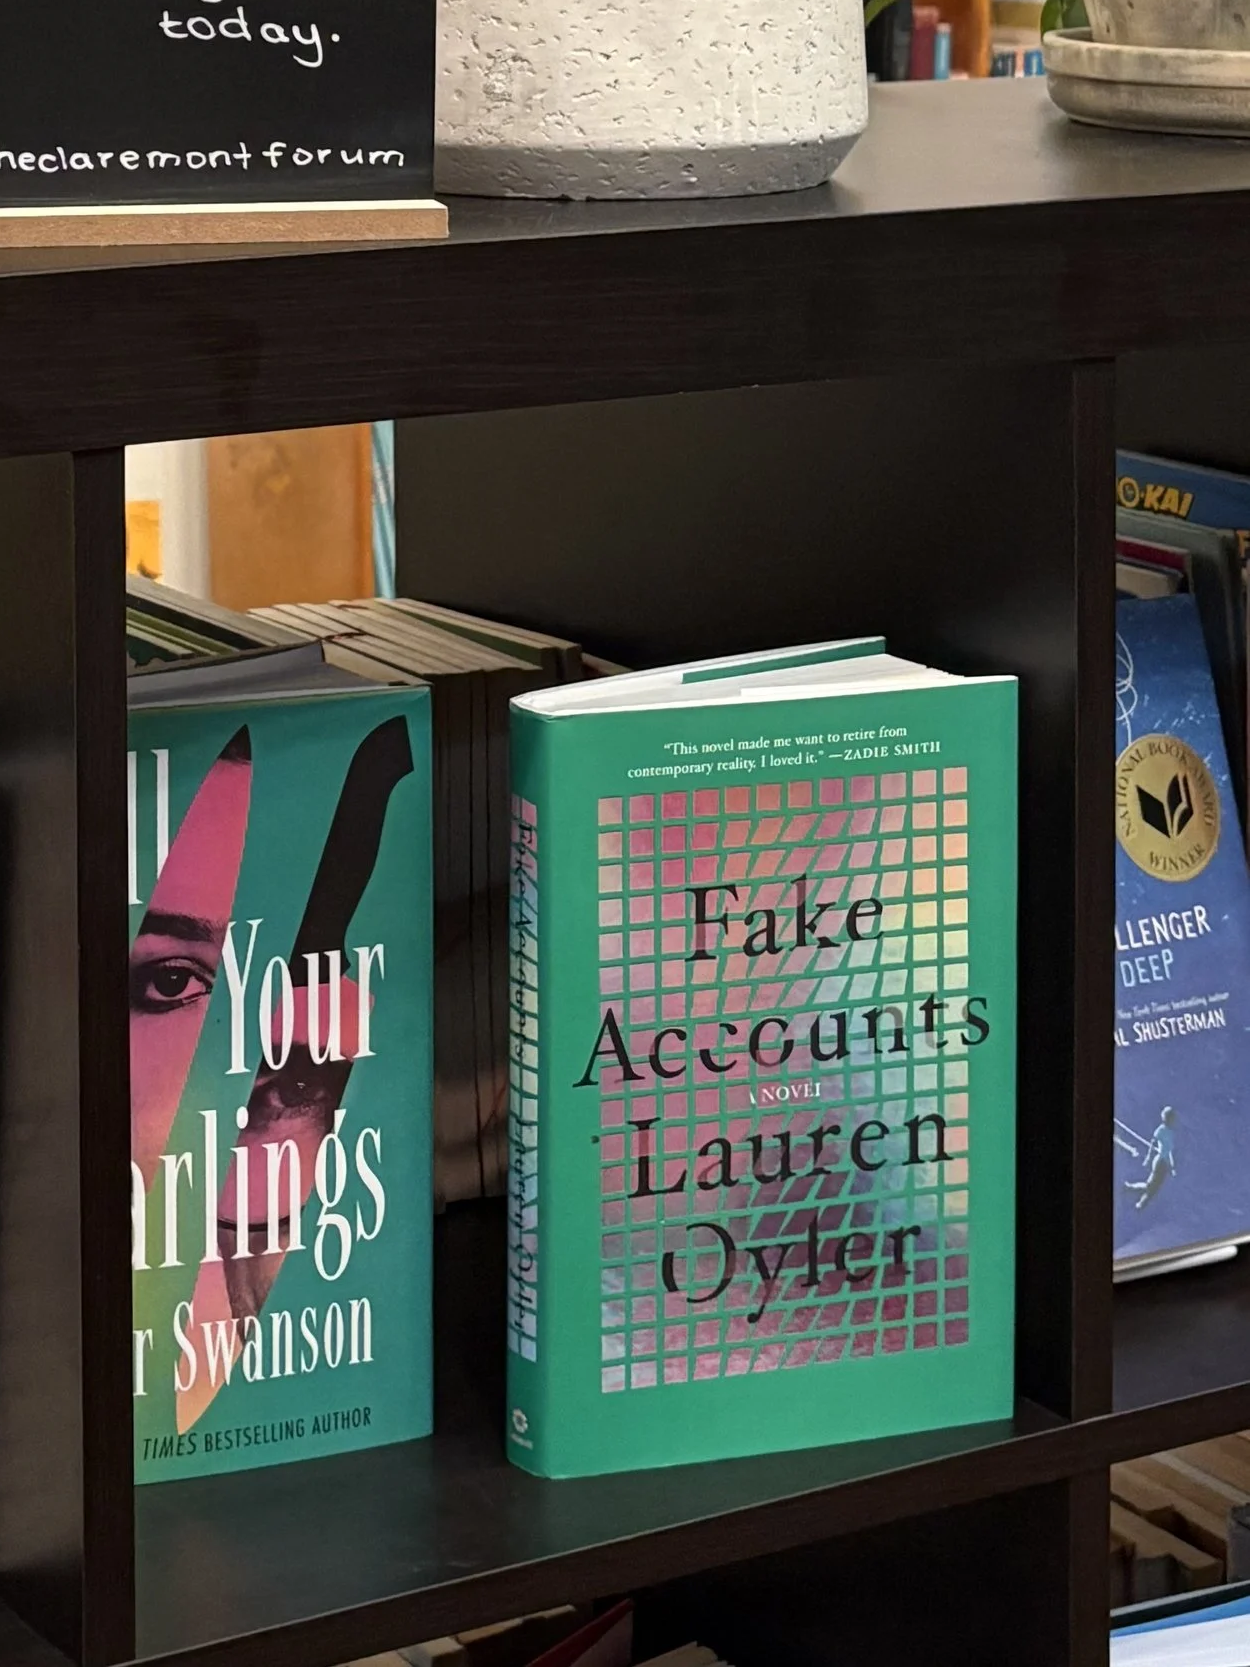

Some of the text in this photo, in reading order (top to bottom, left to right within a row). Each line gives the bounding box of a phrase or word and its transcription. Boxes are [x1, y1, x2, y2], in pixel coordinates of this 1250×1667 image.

[158, 6, 340, 68] today.
[628, 760, 714, 778] contemporary
[770, 752, 803, 766] loved
[894, 741, 942, 756] SMITH
[701, 738, 734, 752] novel
[738, 735, 770, 750] made
[774, 738, 792, 747] me
[795, 734, 824, 745] want
[827, 733, 840, 743] to
[843, 728, 876, 741] retire
[878, 725, 908, 737] from
[686, 873, 884, 962] Fake
[221, 918, 385, 1075] Your
[1120, 948, 1174, 988] DEEP
[573, 992, 990, 1088] Accounts
[1133, 1007, 1227, 1043] SHUSTERMAN
[627, 1110, 955, 1199] Lauren
[661, 1217, 922, 1324] Oyler
[174, 1297, 375, 1392] Swanson
[143, 1406, 372, 1461] TIMES BESTSELLING AUTHOR
